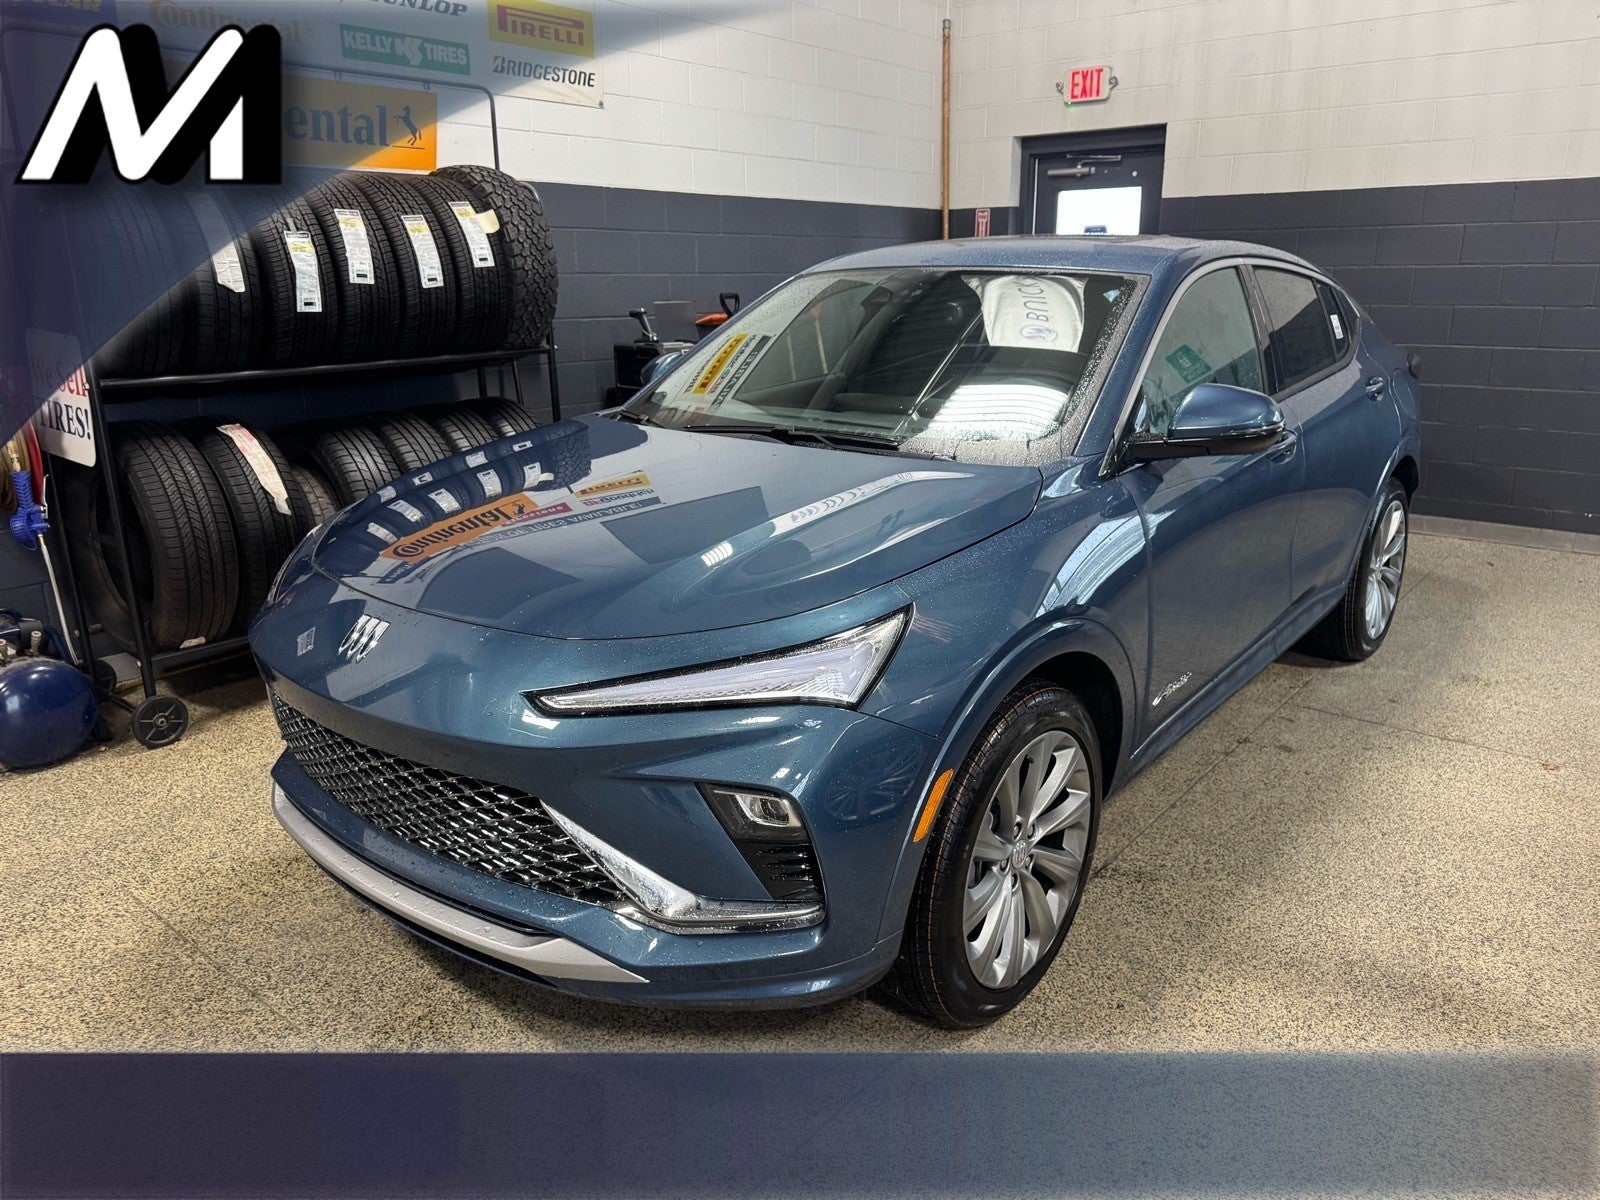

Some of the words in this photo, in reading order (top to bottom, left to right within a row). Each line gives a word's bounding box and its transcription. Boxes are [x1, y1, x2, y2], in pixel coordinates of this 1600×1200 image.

[496, 4, 584, 46] PIRELLI
[342, 29, 393, 54] KELLY
[423, 42, 468, 66] TIRES
[491, 55, 596, 88] BRIDGESTONE
[1070, 68, 1104, 99] EXIT
